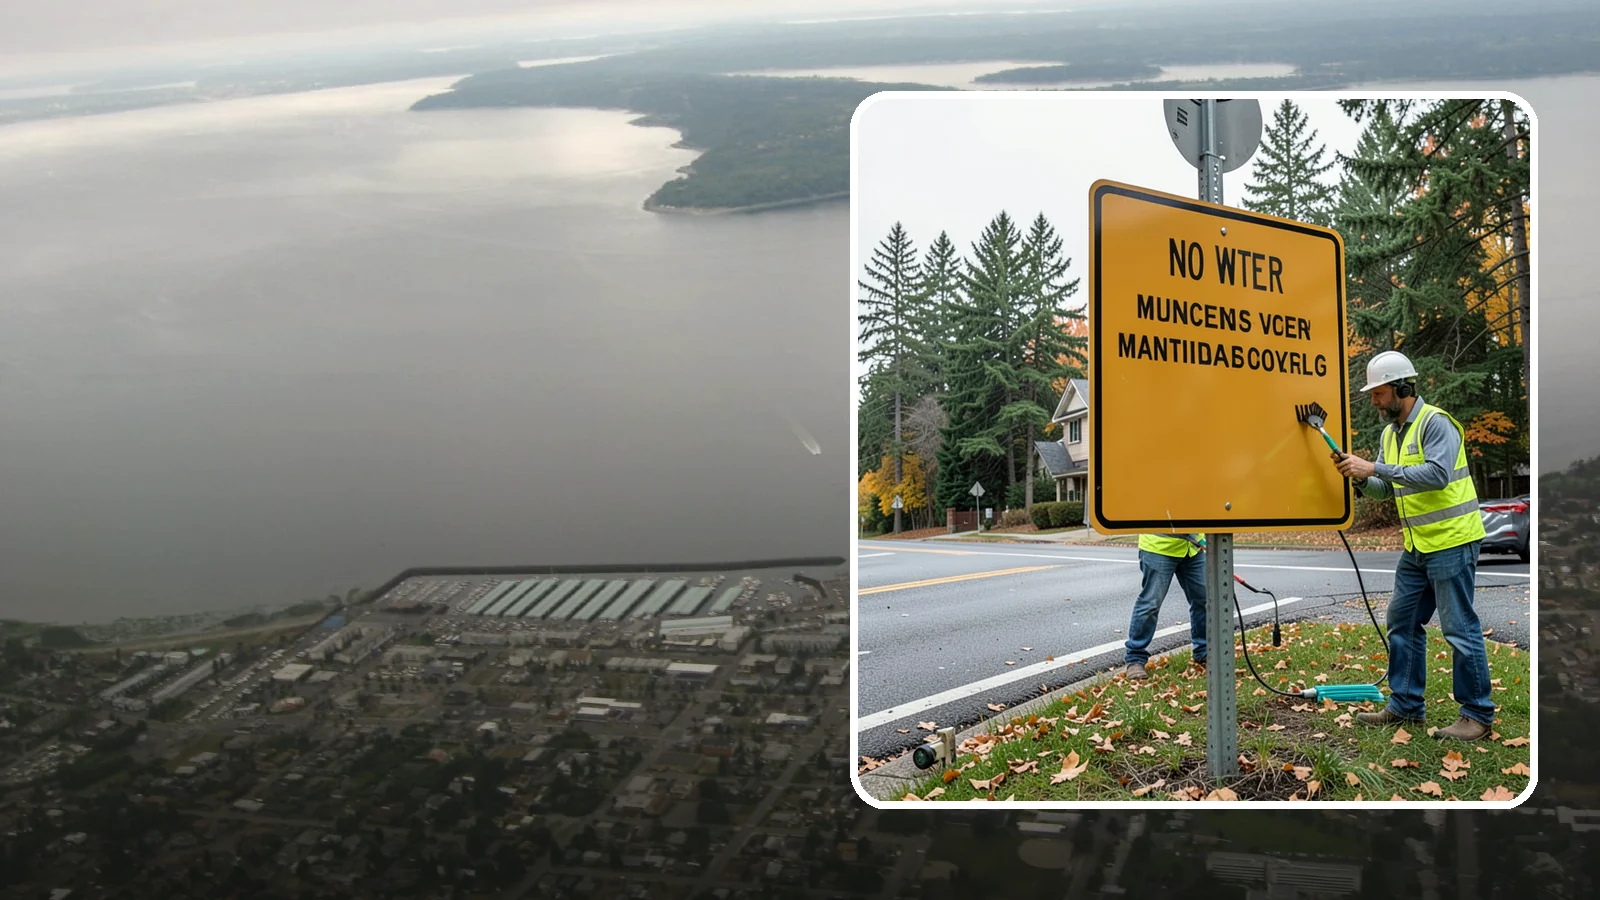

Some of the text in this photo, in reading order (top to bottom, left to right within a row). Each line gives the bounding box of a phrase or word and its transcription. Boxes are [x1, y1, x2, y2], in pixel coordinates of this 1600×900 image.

[1169, 238, 1284, 294] NO WTER
[1137, 294, 1251, 333] MUNCENS
